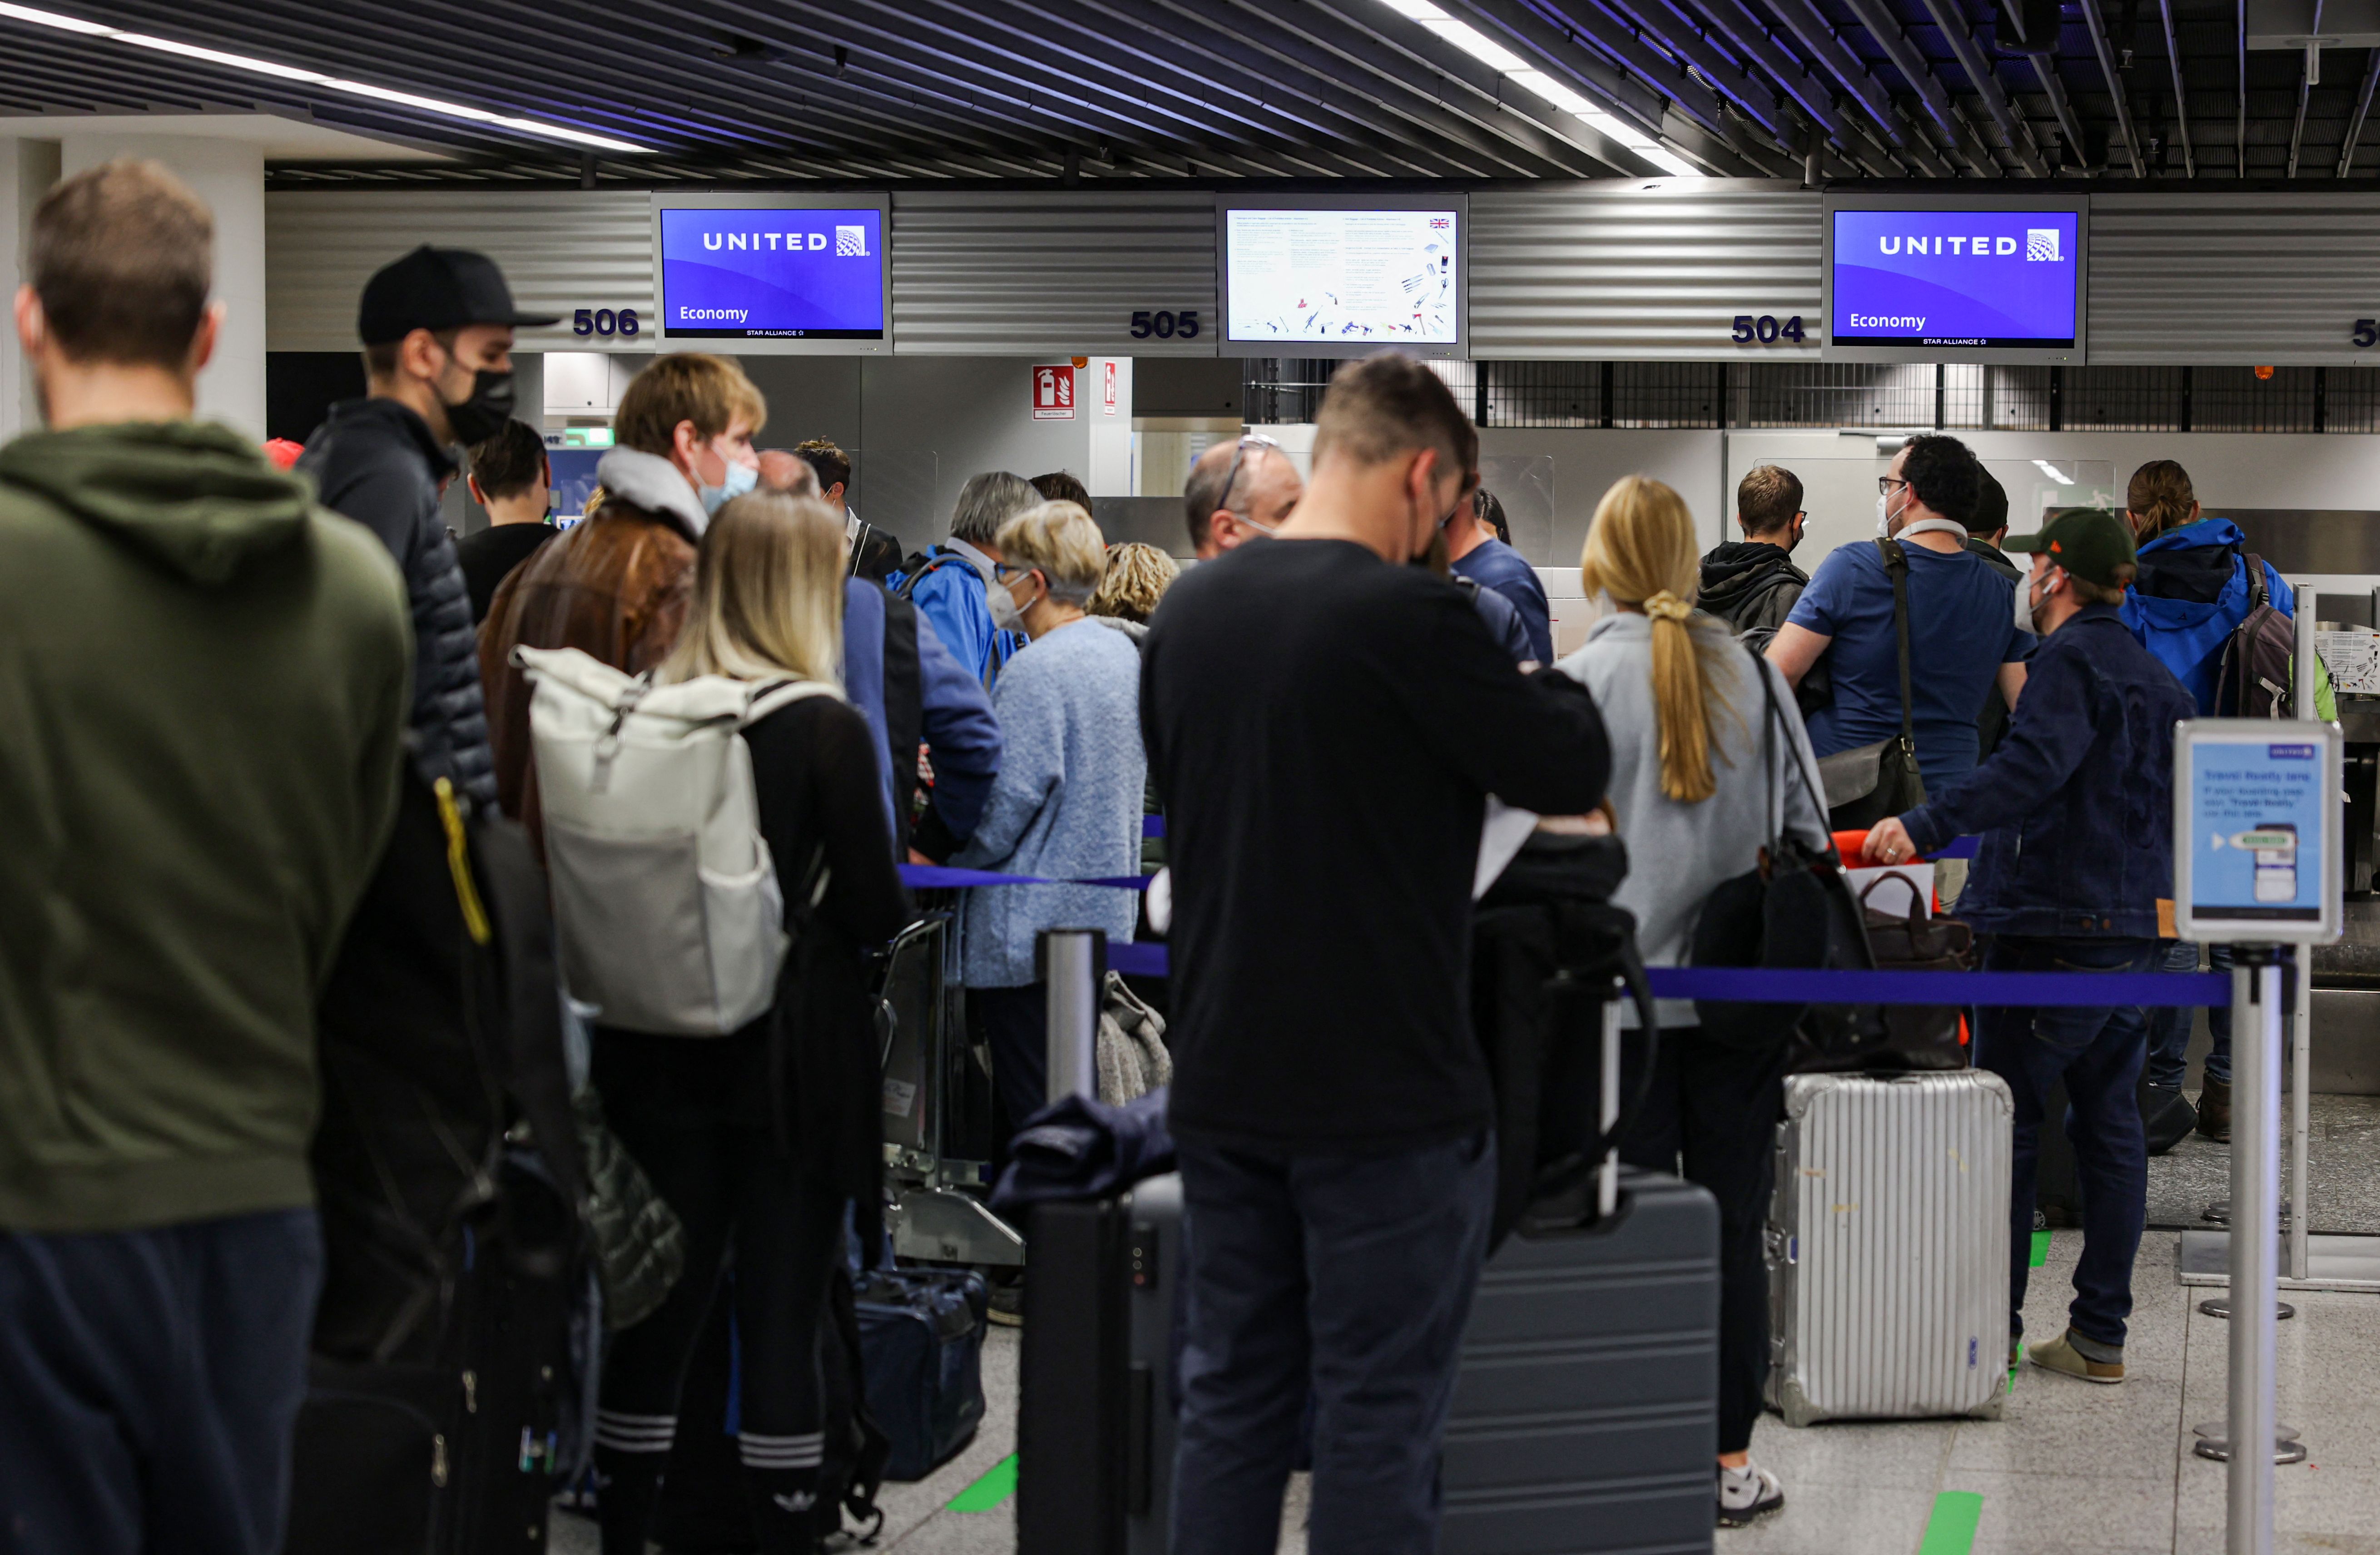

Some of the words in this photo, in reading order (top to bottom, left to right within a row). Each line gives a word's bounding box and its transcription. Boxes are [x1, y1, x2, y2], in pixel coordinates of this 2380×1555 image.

[704, 233, 827, 251] UNITED
[1880, 236, 2017, 255] UNITED
[574, 309, 639, 336] 506
[680, 306, 749, 323] Economy
[1850, 313, 1926, 332] Economy
[1130, 311, 1199, 339] 505
[1732, 315, 1805, 344] 504
